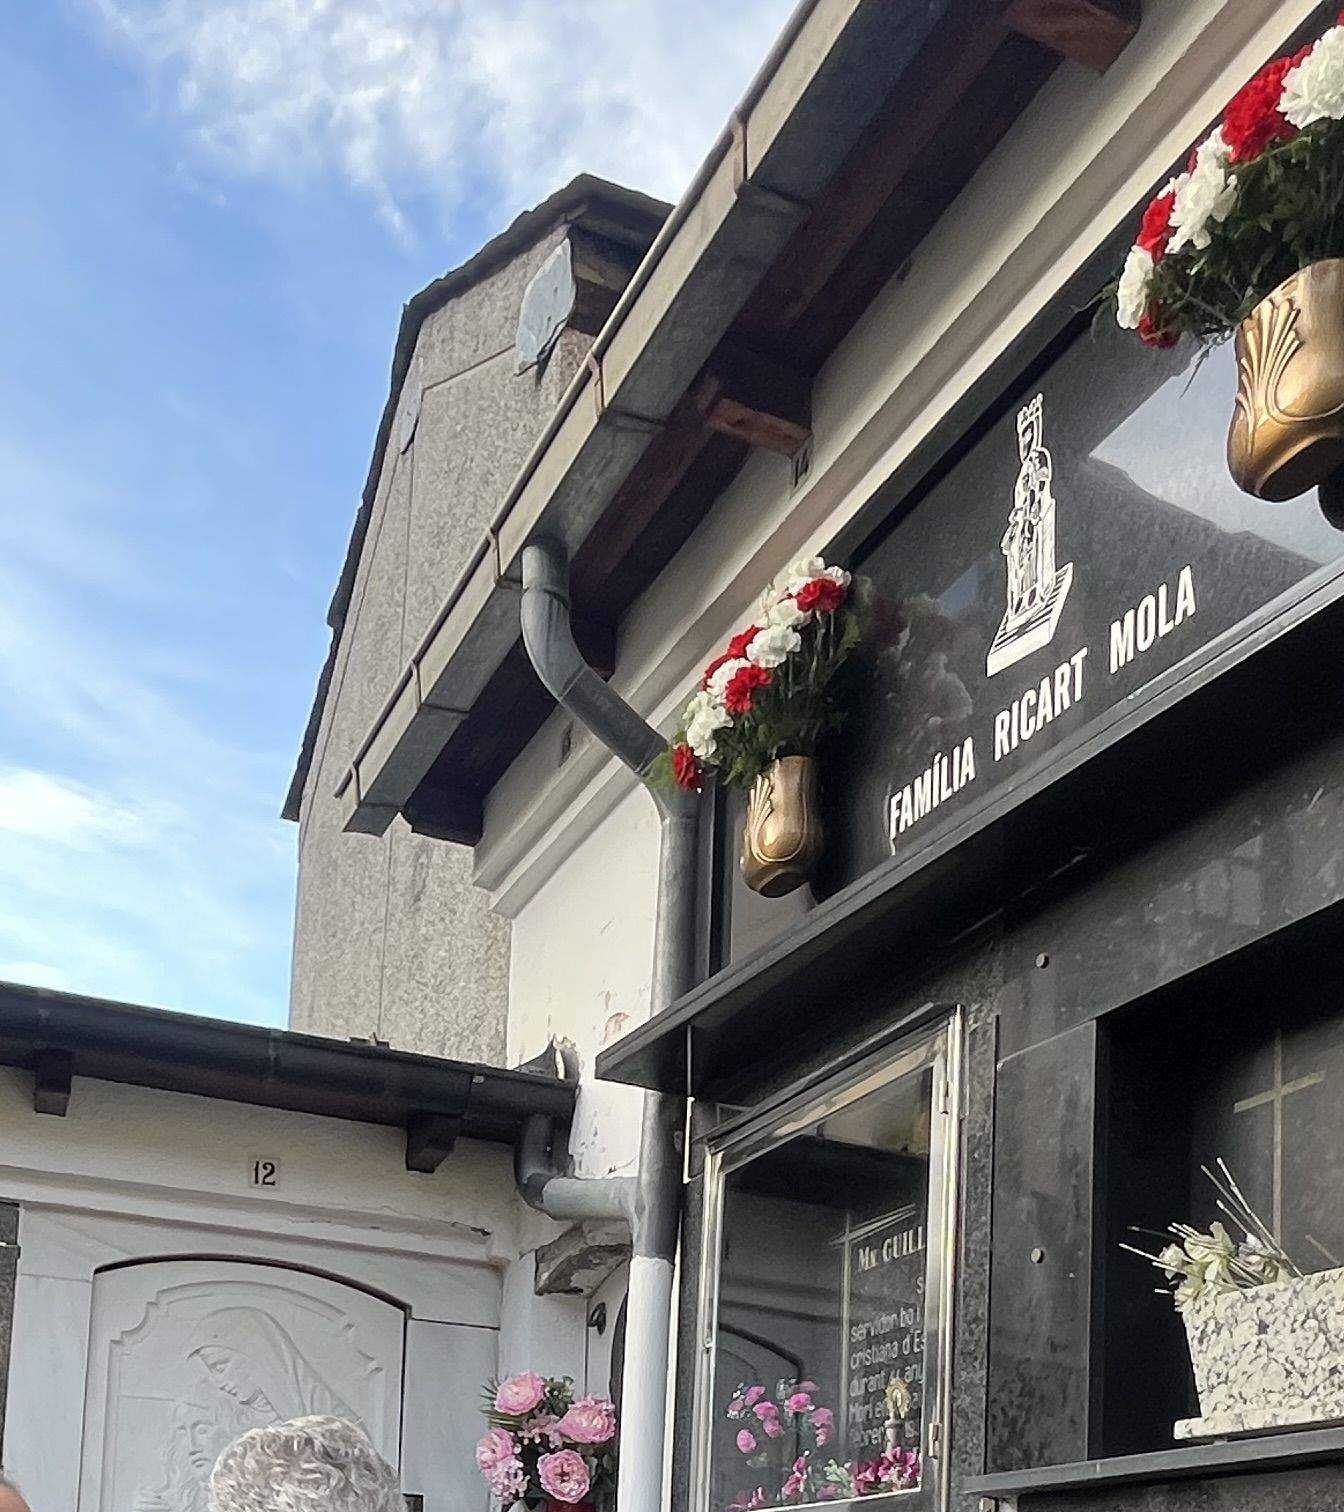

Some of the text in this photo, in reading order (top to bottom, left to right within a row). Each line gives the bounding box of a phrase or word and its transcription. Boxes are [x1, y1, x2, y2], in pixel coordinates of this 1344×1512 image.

[888, 563, 1197, 841] FAMÍLIA RICART MOLA
[254, 1160, 276, 1186] 12
